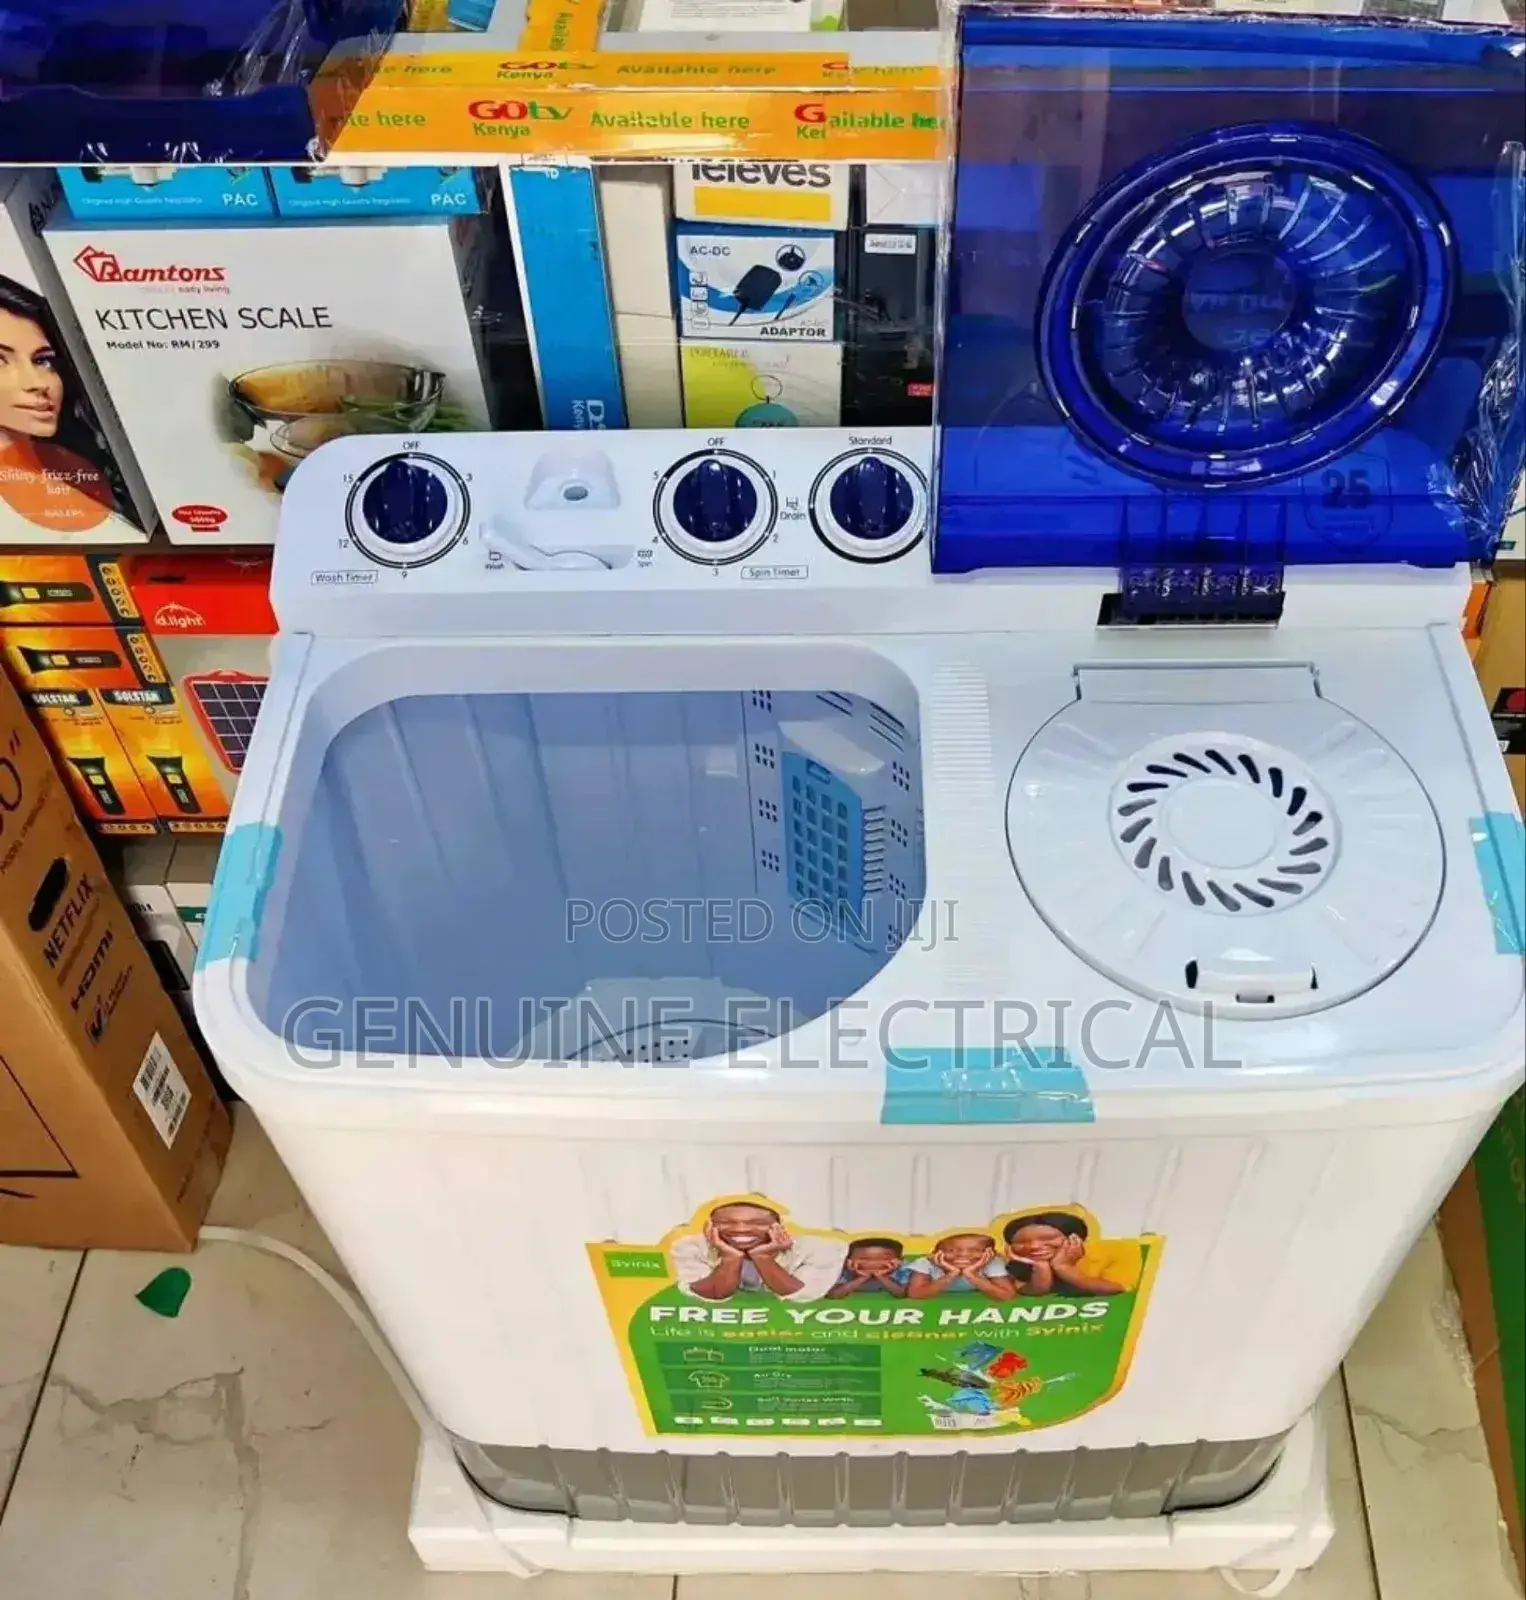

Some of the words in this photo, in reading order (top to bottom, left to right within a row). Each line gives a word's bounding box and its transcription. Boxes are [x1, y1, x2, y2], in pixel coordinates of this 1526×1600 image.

[376, 110, 426, 127] here
[467, 100, 574, 121] GOtv
[590, 110, 692, 128] Available
[701, 111, 750, 128] here
[472, 123, 531, 139] Kenya
[221, 193, 260, 206] PAC
[430, 193, 468, 206] PAC
[95, 308, 230, 332] KITCHEN
[237, 306, 333, 330] SCALE
[759, 326, 828, 338] ADAPTOR
[105, 339, 145, 350] Model
[146, 339, 169, 350] No:
[170, 338, 221, 351] RM/299
[402, 440, 421, 451] OFF
[707, 437, 725, 447] OFF
[848, 435, 893, 447] Standard
[342, 474, 354, 484] 15
[466, 473, 473, 482] 3
[779, 510, 807, 521] Drain
[338, 538, 350, 549] 12
[461, 536, 469, 546] 6
[651, 536, 660, 545] 4
[772, 535, 780, 544] 2
[315, 572, 343, 584] Wash
[400, 571, 408, 581] 9
[712, 568, 720, 578] 3
[749, 567, 773, 579] Spin
[43, 872, 94, 969] NETFLIX
[650, 1306, 770, 1325] FREE
[785, 1308, 925, 1326] YOUR
[938, 1301, 1110, 1326] HANDS
[650, 1326, 691, 1338] Life
[699, 1326, 715, 1338] is
[810, 1326, 859, 1339] and
[973, 1324, 1020, 1338] with
